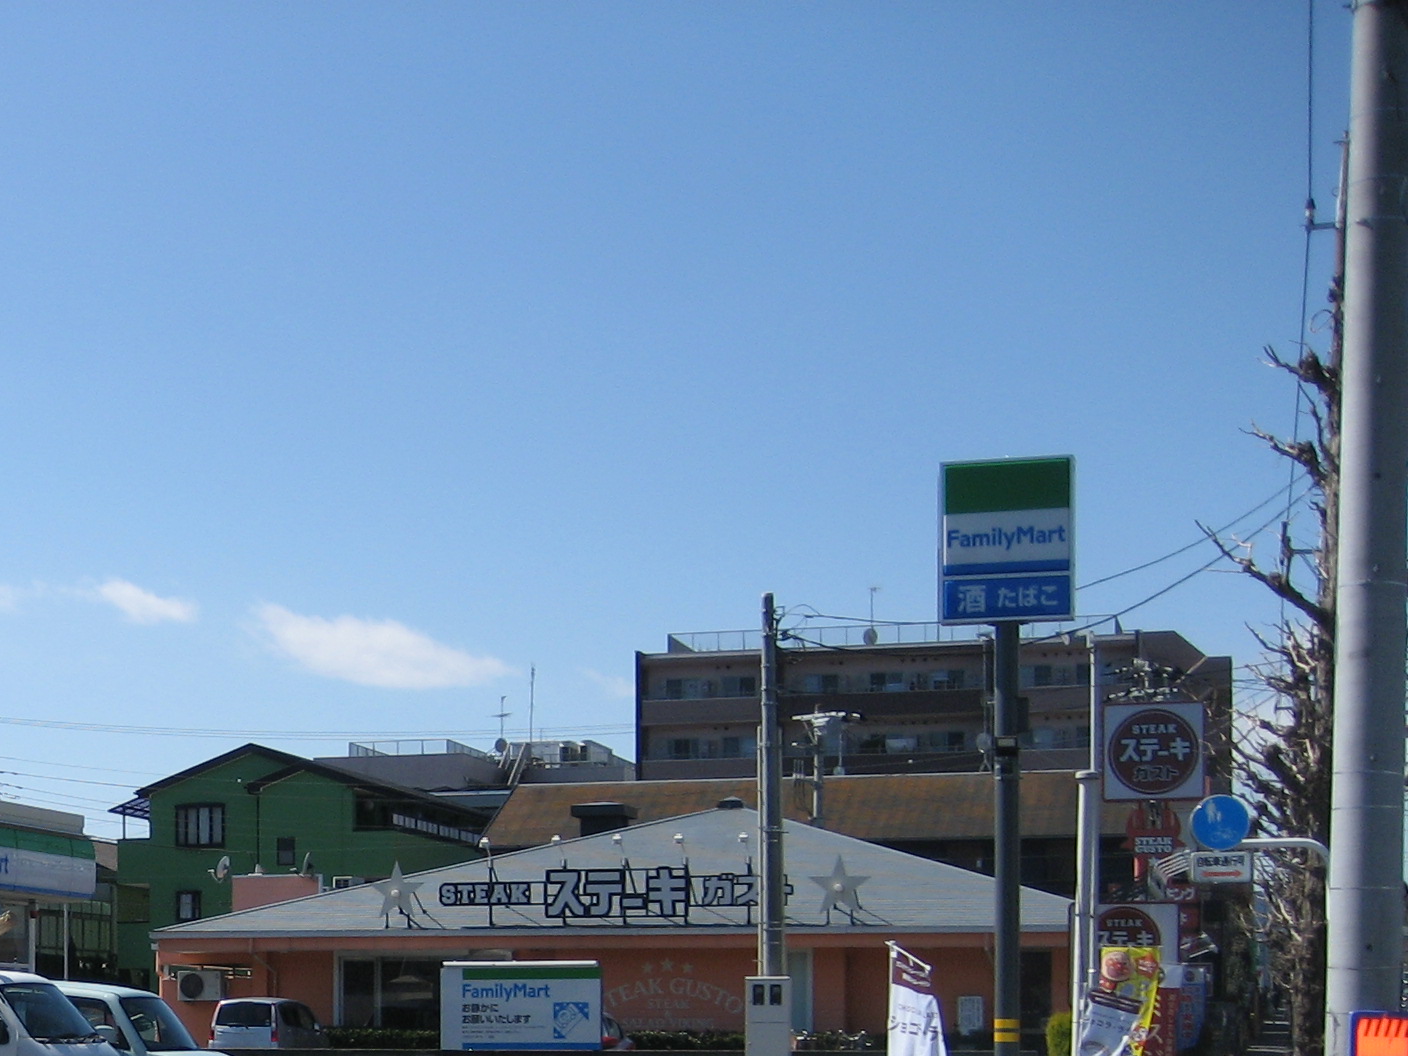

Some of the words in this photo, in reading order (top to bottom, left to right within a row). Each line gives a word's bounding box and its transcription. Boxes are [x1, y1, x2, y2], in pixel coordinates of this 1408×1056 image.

[947, 524, 1067, 551] FamilyMart
[957, 584, 987, 614] 酒
[997, 585, 1059, 608] たばこ
[1131, 723, 1178, 735] STEAK
[1119, 737, 1191, 763] ステーキ
[1133, 765, 1180, 781] ガスト
[1135, 836, 1173, 846] STEAK
[440, 882, 531, 905] STEAK
[546, 867, 689, 917] ステーキ
[1106, 918, 1143, 928] STEAK
[462, 983, 550, 1002] FamilyMart
[603, 978, 666, 1009] TEAK
[669, 977, 743, 1014] GUSTO
[462, 1014, 531, 1025] お願いいたします
